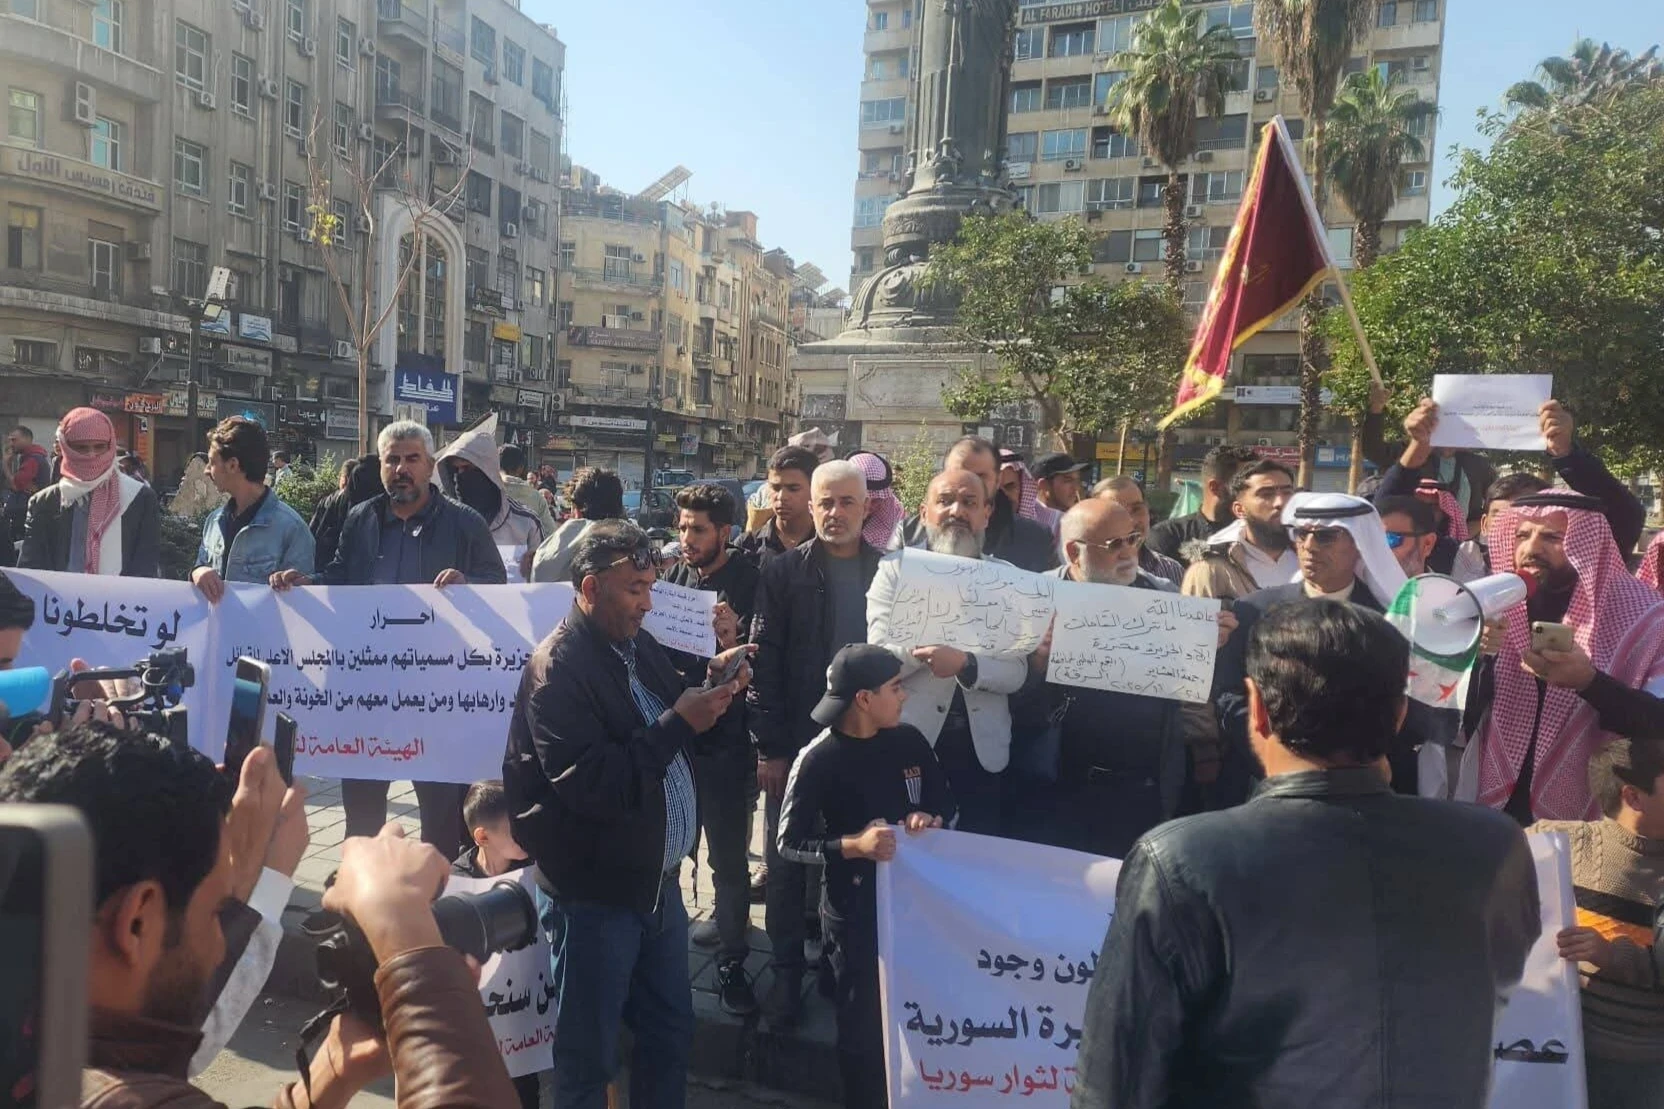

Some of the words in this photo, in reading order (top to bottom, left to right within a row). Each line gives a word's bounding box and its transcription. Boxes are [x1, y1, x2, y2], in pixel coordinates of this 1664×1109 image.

[1023, 11, 1037, 22] AL
[1085, 2, 1119, 16] HOTEL
[42, 592, 148, 637] تخلطونا
[367, 606, 435, 628] احرار
[151, 609, 181, 649] لو
[347, 645, 388, 672] ممثلين
[390, 648, 454, 672] مسمياتهم
[457, 648, 493, 671] بكل
[494, 648, 531, 671] جزيرة
[294, 687, 333, 711] الخونة
[335, 691, 354, 712] من
[356, 694, 388, 712] معهم
[391, 690, 426, 713] يعمل
[428, 691, 455, 713] ومن
[457, 689, 506, 714] وارهابها
[308, 737, 365, 757] العامة
[367, 737, 424, 760] الهيئة
[977, 944, 1044, 979] وجود
[1053, 950, 1099, 985] لون
[904, 999, 1029, 1045] السورية
[918, 1060, 994, 1093] سوريا
[997, 1064, 1059, 1095] لثوار
